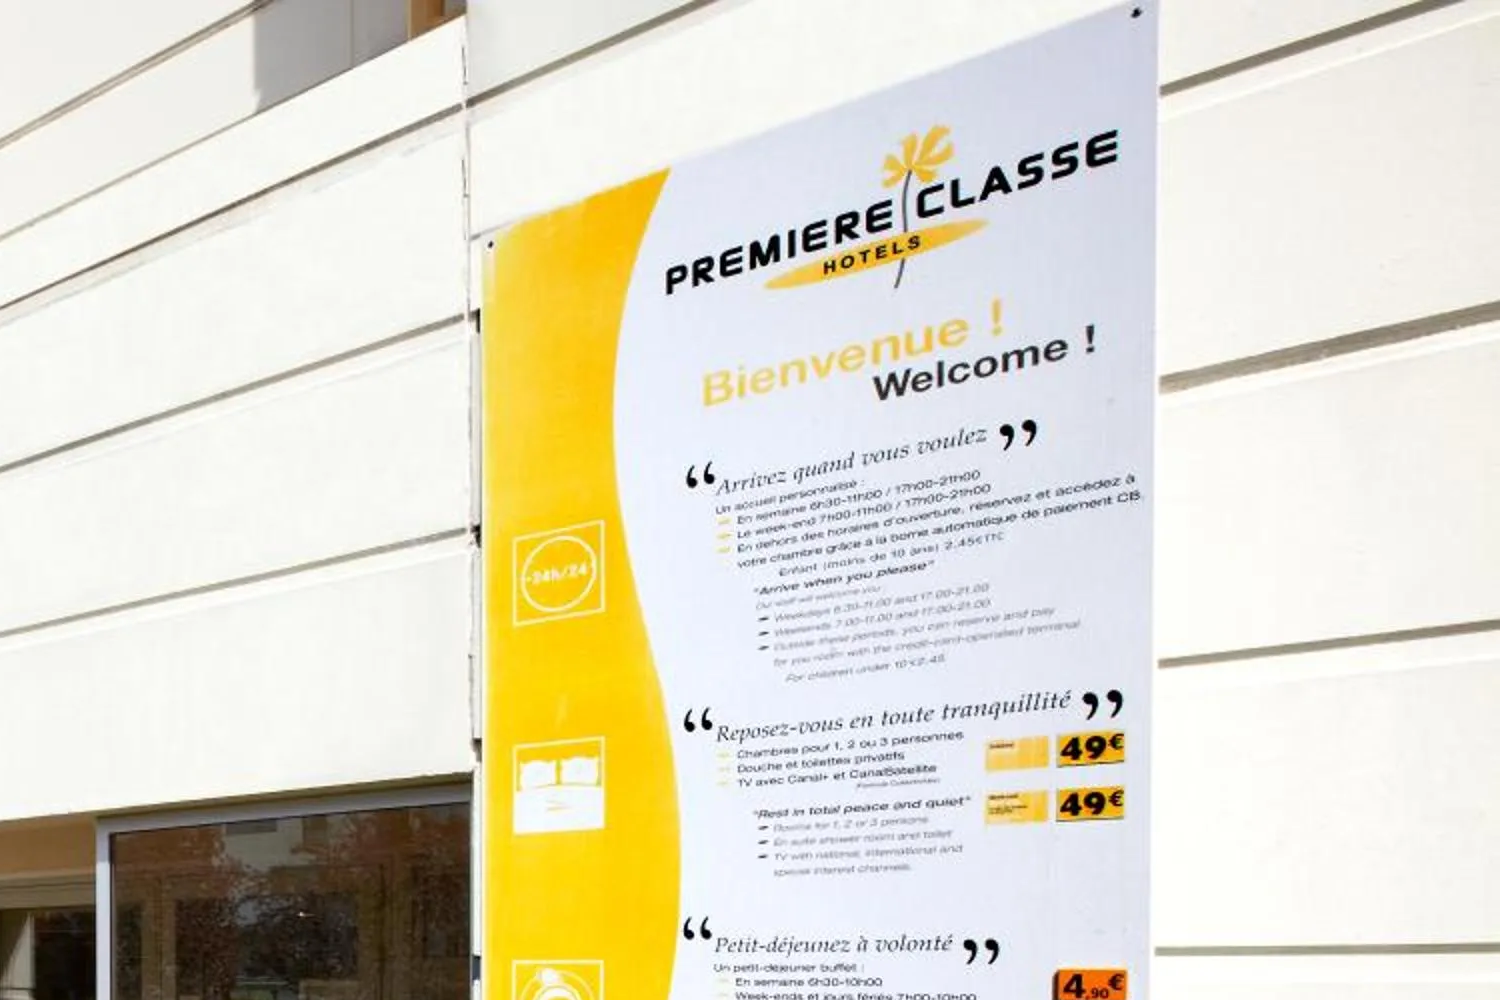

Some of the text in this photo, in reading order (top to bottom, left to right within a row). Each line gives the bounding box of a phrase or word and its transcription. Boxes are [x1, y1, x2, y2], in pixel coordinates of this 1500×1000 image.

[665, 130, 1118, 295] PREMIERE CLASSE
[823, 235, 921, 275] HOTELS
[703, 317, 968, 406] Bienvenue
[873, 338, 1069, 400] Welcome
[716, 427, 987, 496] Arrivez quand vous voulez
[715, 504, 731, 515] Un
[734, 495, 776, 511] accueil
[737, 515, 751, 525] En
[756, 504, 806, 521] semaine
[737, 543, 752, 554] En
[756, 535, 798, 551] dehors
[802, 530, 824, 543] des
[827, 519, 879, 538] horaires
[1035, 488, 1050, 500] et
[737, 530, 751, 540] Le
[755, 516, 815, 536] week-end
[737, 555, 767, 568] votre
[770, 546, 822, 564] chambre
[826, 538, 861, 555] grâce
[875, 534, 887, 545] la
[891, 528, 928, 544] borne
[932, 513, 1017, 537] automatique
[1021, 509, 1040, 521] de
[1044, 497, 1113, 518] paiement
[779, 562, 817, 577] Enfant
[869, 551, 886, 562] de
[890, 547, 906, 558] 10
[803, 574, 842, 589] when
[846, 569, 873, 585] you
[1003, 609, 1028, 621] and
[717, 690, 1071, 744] Reposez-vous en toute tranquillité
[737, 746, 798, 759] Chambres
[801, 743, 830, 756] pour
[859, 738, 877, 748] ou
[891, 731, 964, 747] personnes
[737, 751, 905, 774] Douche et toilettes privatifs
[737, 778, 753, 787] TV
[755, 776, 784, 787] avec
[833, 770, 846, 780] et
[792, 807, 805, 817] in
[809, 804, 840, 816] total
[843, 802, 889, 815] peace
[892, 798, 921, 811] and
[939, 844, 963, 855] and
[714, 933, 952, 957] Petit-déjeunez à volonté
[713, 963, 731, 973] Un
[820, 962, 857, 973] buffet
[735, 977, 883, 988] En semaine 6h30-10h00
